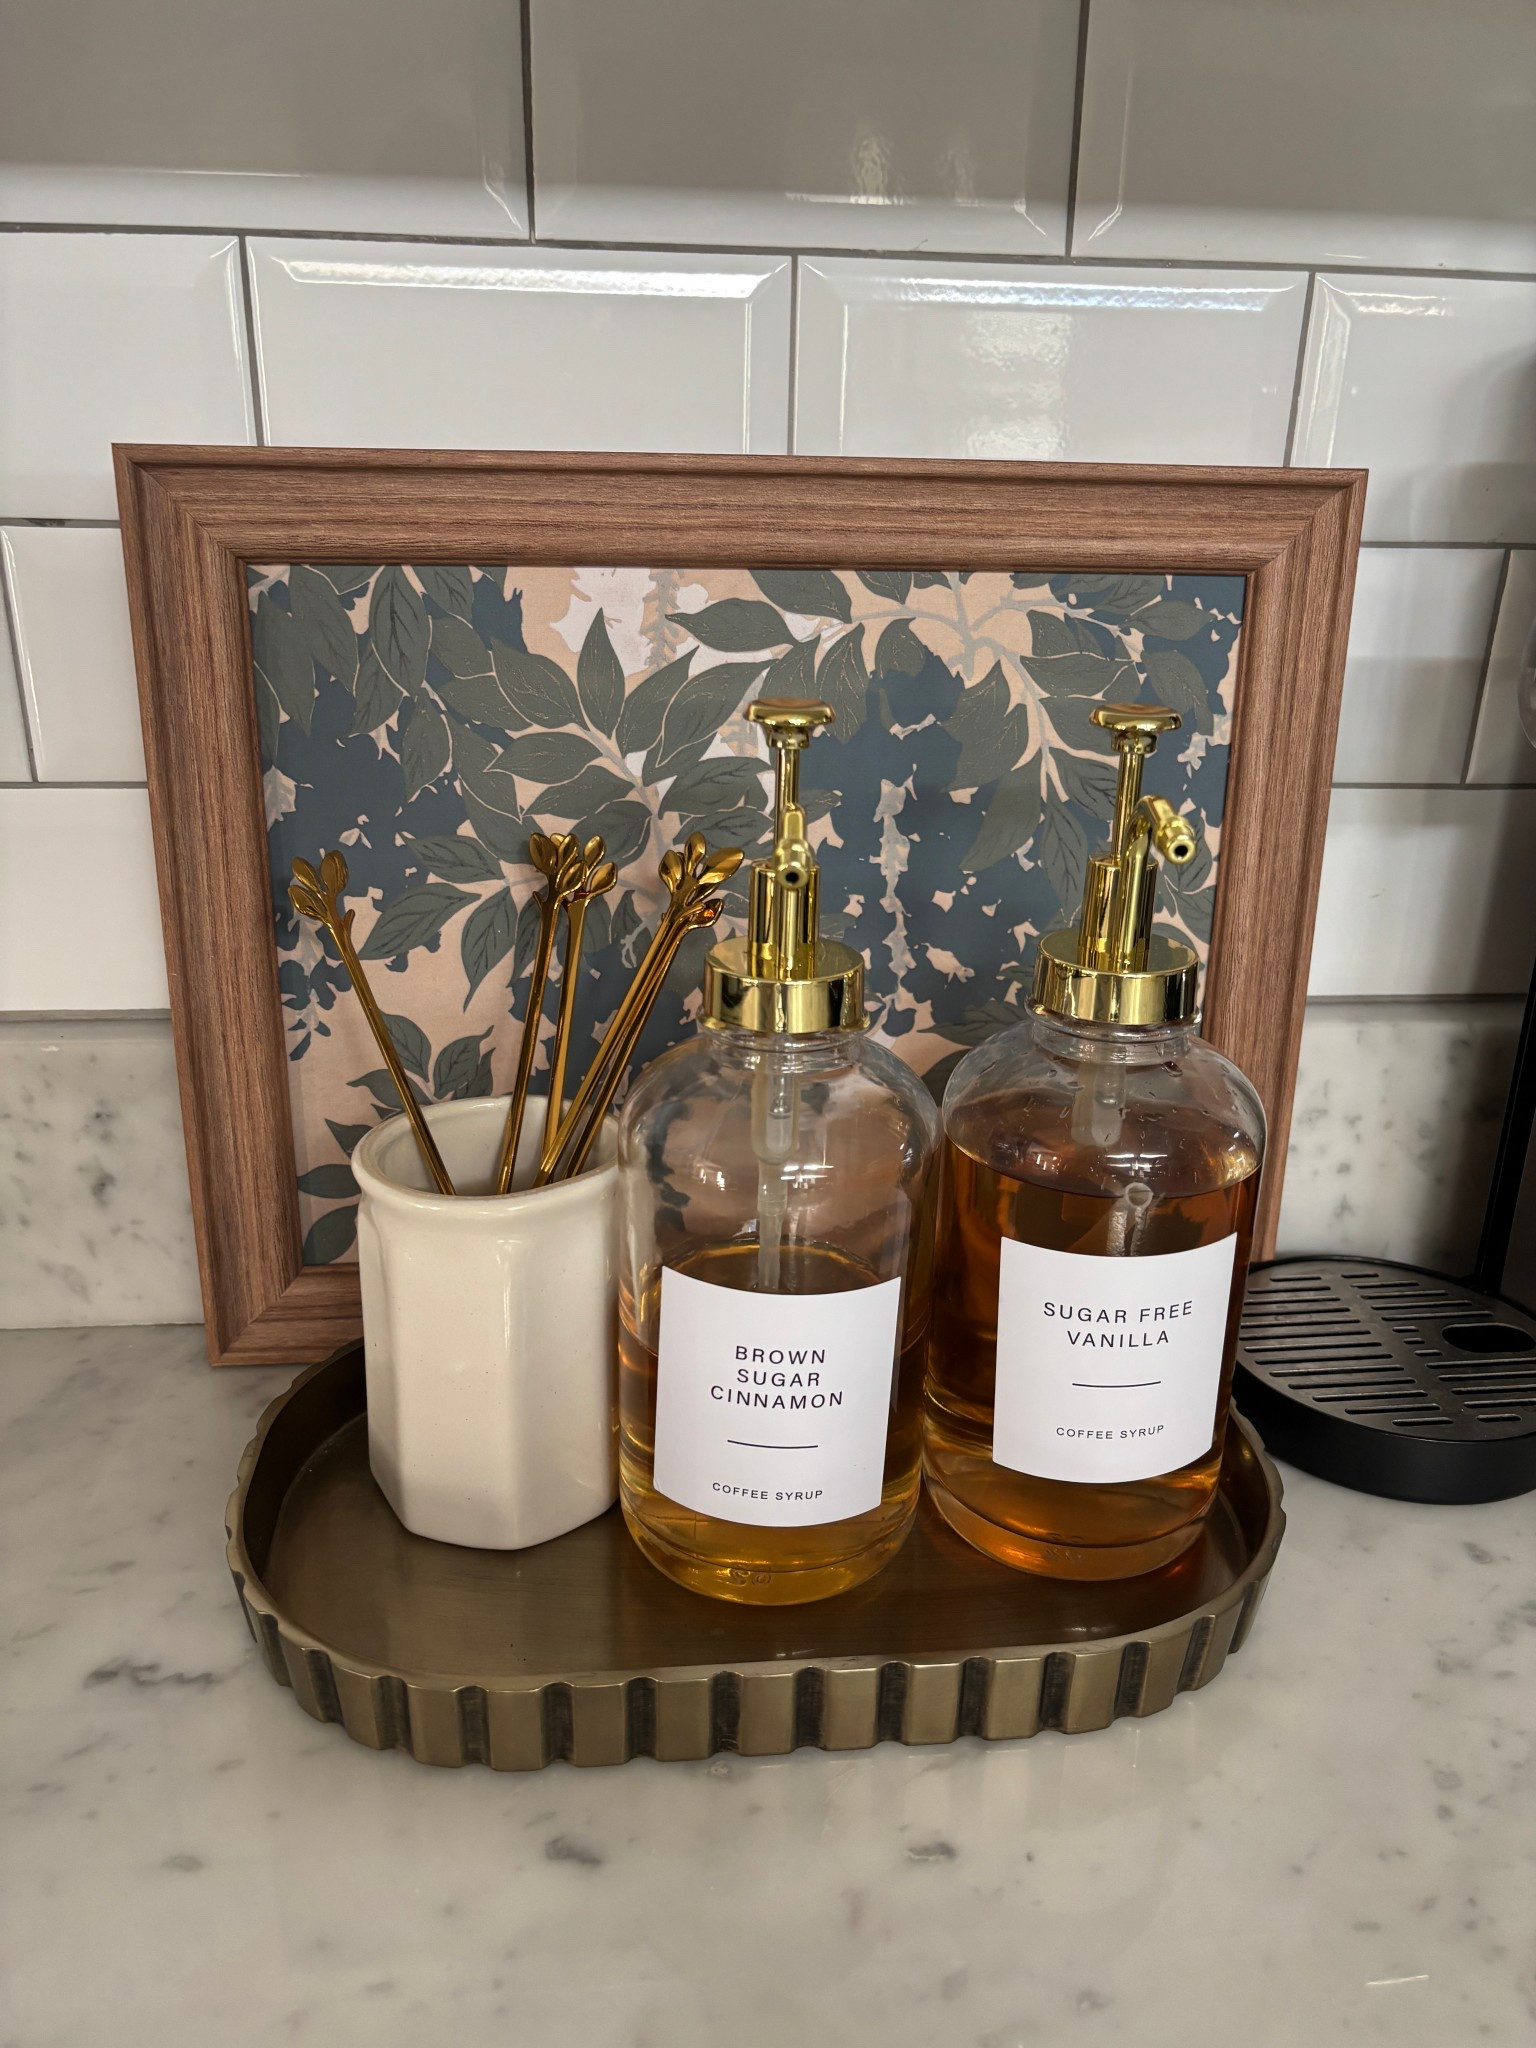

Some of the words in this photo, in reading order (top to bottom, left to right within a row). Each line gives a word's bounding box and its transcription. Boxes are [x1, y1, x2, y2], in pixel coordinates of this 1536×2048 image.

[1043, 1301, 1127, 1324] SUGAR
[1139, 1300, 1194, 1323] FREE
[1066, 1330, 1169, 1348] VANILLA
[735, 1345, 826, 1365] BROWN
[736, 1368, 820, 1388] SUGAR
[710, 1385, 843, 1410] CINNAMON
[1056, 1427, 1113, 1440] COFFEE
[1119, 1424, 1165, 1439] SYRUP
[712, 1482, 769, 1500] COFFEE
[775, 1489, 823, 1501] SYRUP
